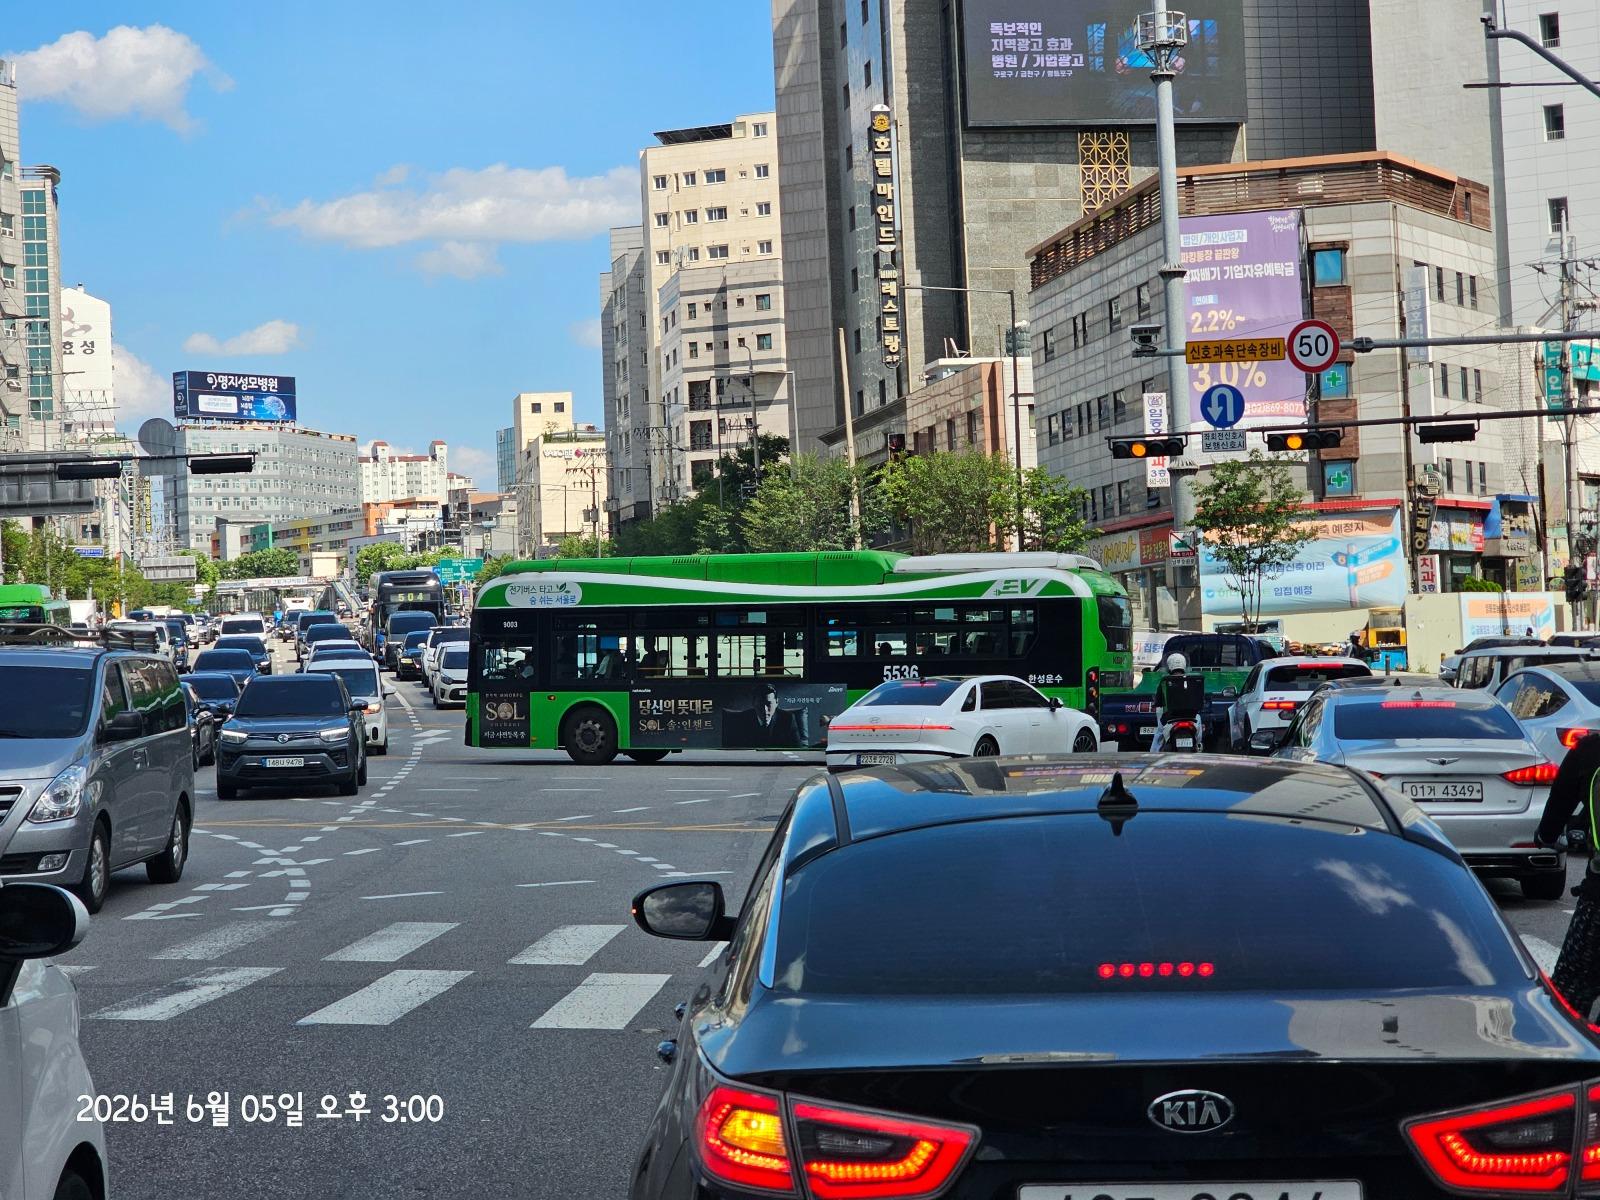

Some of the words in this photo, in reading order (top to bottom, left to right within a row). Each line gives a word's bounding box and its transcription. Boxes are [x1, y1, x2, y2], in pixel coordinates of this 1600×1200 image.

[990, 22, 1042, 36] 독보적인
[991, 38, 1044, 52] 지역광고
[1046, 38, 1073, 51] 효과
[991, 54, 1018, 68] 병원
[1033, 54, 1084, 68] 기업광고
[1223, 262, 1295, 280] 기업자유예탁금
[62, 340, 95, 355] 효성
[1190, 343, 1282, 360] 신호과속단속장비
[1298, 335, 1329, 357] 50
[217, 375, 278, 392] 명지성모병원
[1203, 432, 1245, 441] 좌회전신호시
[1203, 441, 1245, 450] 보행신호시
[1332, 521, 1365, 534] 예정지
[1306, 561, 1325, 571] 이전
[1421, 557, 1436, 583] 치과
[509, 584, 537, 595] 전기버스
[539, 584, 553, 594] 타고
[1000, 579, 1041, 596] EV
[1274, 586, 1293, 596] 입점
[1294, 585, 1313, 596] 예정
[398, 593, 424, 602] 504
[555, 595, 577, 605] 서울로
[883, 665, 919, 682] 5536
[1028, 673, 1063, 684] 한성운수
[639, 699, 676, 716] 당신의
[677, 699, 714, 716] 뜻대로
[1442, 783, 1474, 797] 4349
[1162, 1100, 1222, 1126] KIA
